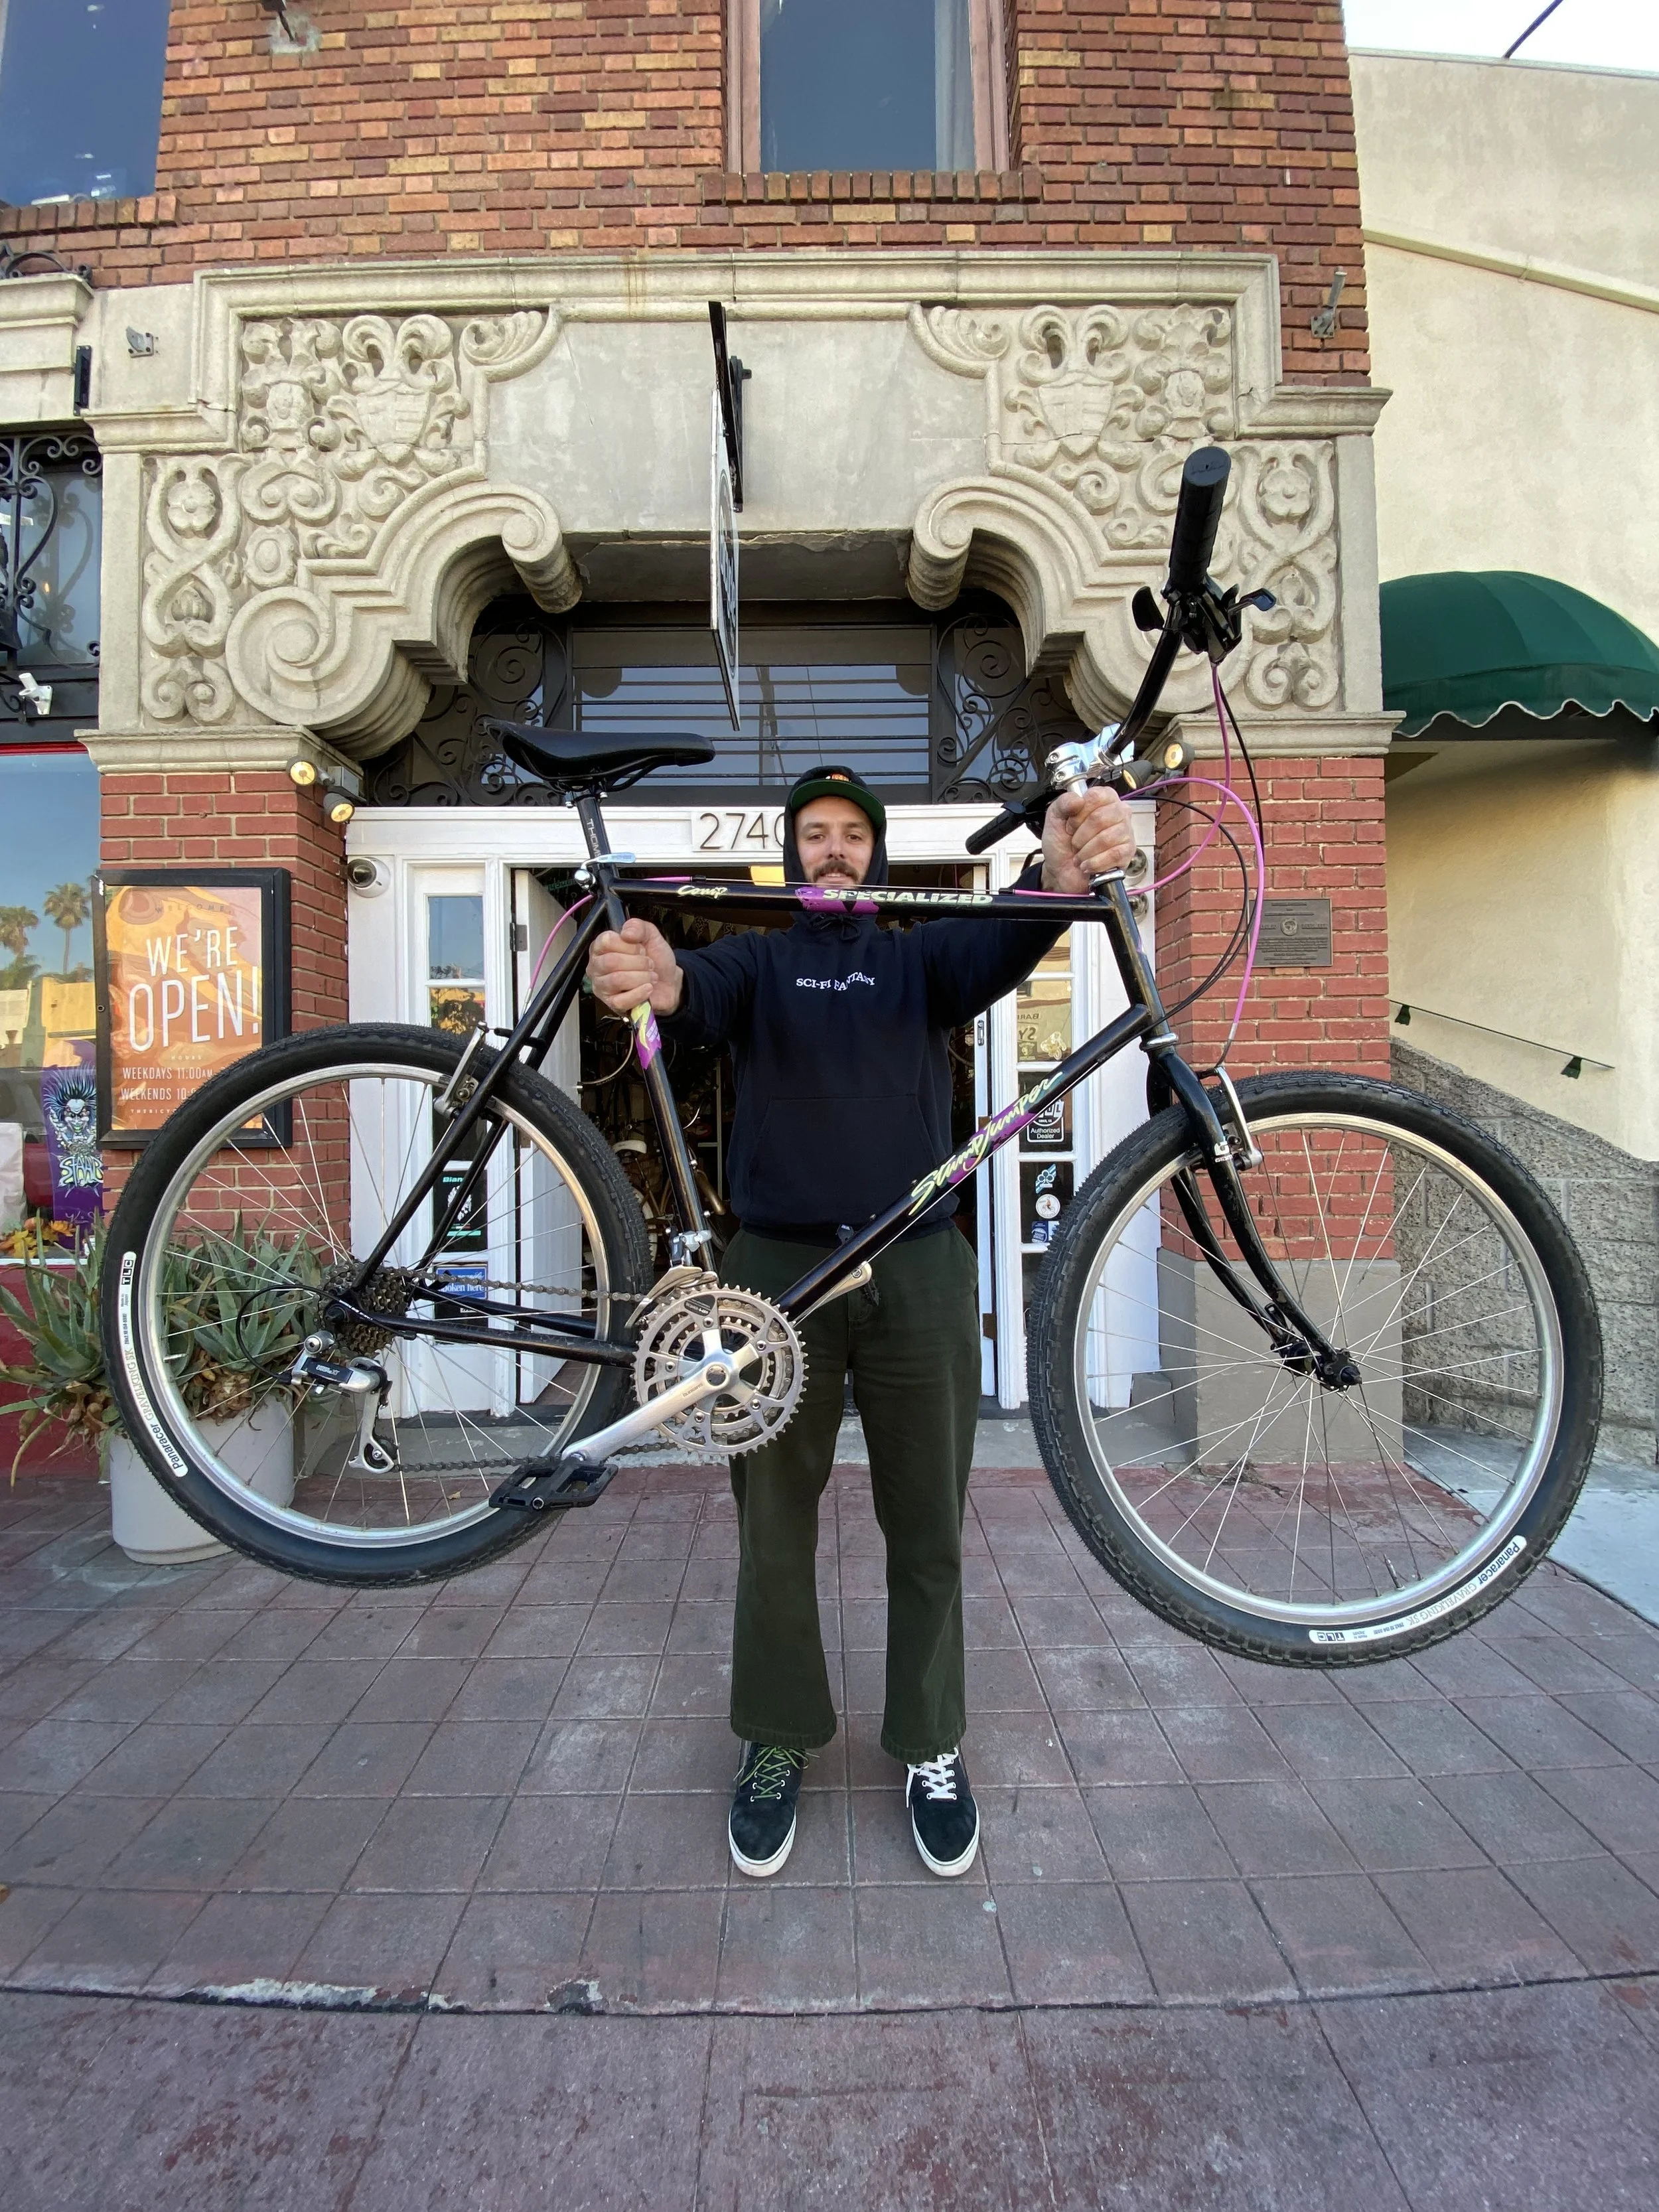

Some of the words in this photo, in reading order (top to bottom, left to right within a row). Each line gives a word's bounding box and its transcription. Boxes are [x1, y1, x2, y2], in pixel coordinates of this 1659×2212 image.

[678, 885, 728, 899] Comp
[823, 889, 993, 907] SPECIALIZED
[146, 926, 238, 977] WE'RE
[796, 978, 831, 990] SCI-FI
[833, 972, 875, 991] FANTASY
[129, 966, 259, 1051] OPEN!
[122, 1067, 173, 1080] WEEKDAYS
[121, 1088, 172, 1100] WEEKENDS
[125, 1347, 136, 1361] SK
[127, 1361, 155, 1421] GRAVELKING
[150, 1424, 184, 1469] Panaracer
[1479, 1541, 1521, 1585] Panaracer
[1420, 1583, 1477, 1621] GRAVELKING
[1406, 1613, 1420, 1625] SK
